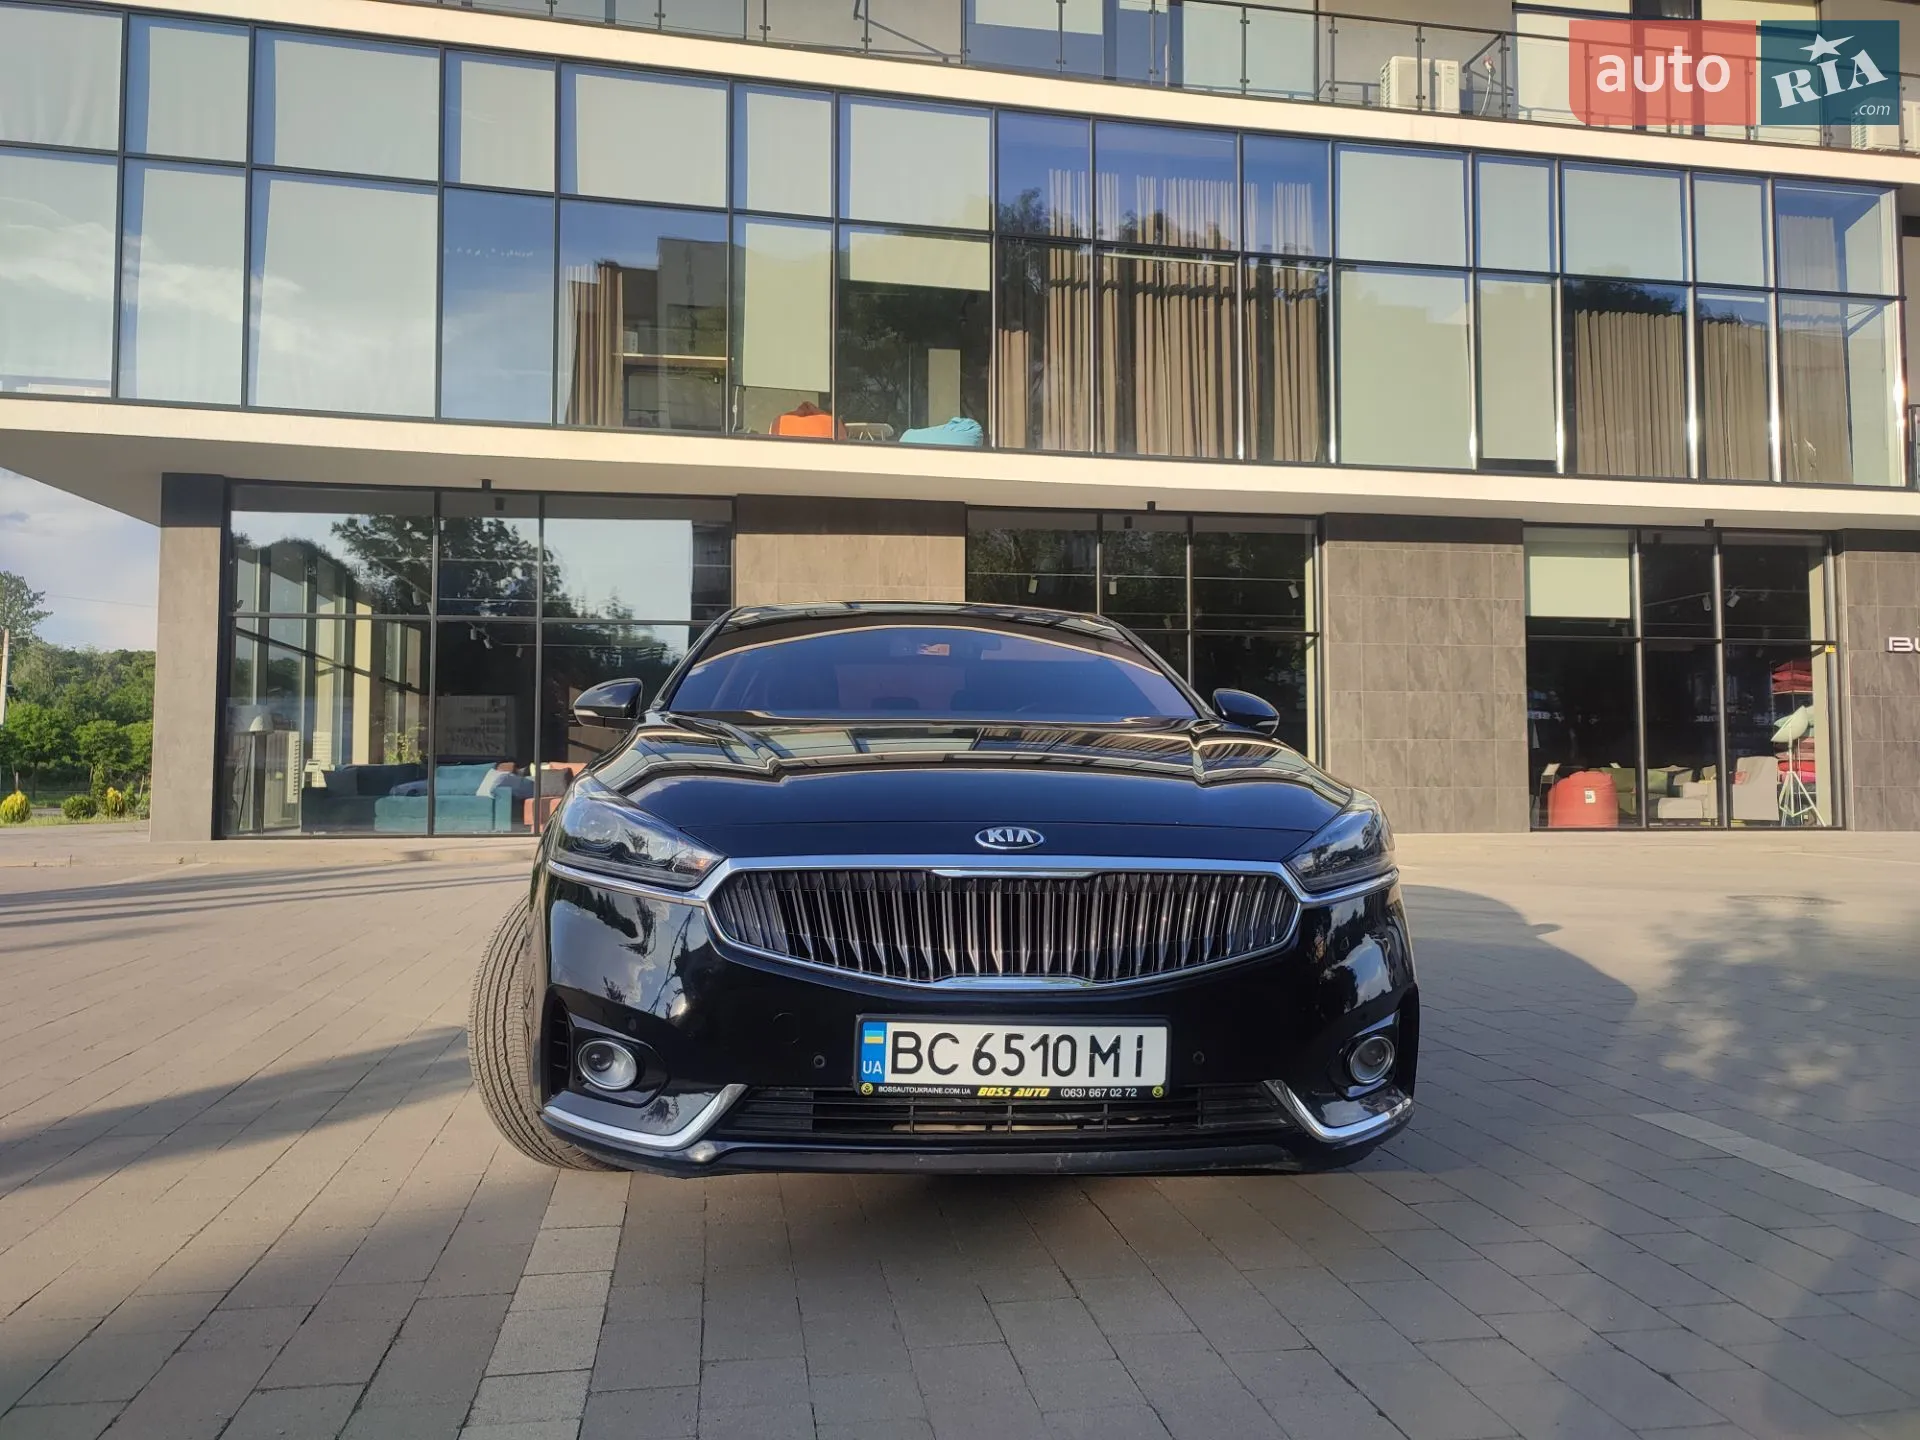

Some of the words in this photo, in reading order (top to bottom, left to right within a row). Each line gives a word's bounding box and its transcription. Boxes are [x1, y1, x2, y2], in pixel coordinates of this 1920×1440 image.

[1889, 636, 1920, 652] B
[986, 829, 1034, 843] KIA
[890, 1030, 960, 1076] BC
[972, 1032, 1077, 1077] 6510
[1088, 1034, 1144, 1078] MI
[863, 1060, 882, 1074] UA
[977, 1087, 1011, 1097] BOSS
[1060, 1087, 1086, 1098] (063)
[1109, 1088, 1122, 1098] 02
[1124, 1088, 1138, 1098] 72
